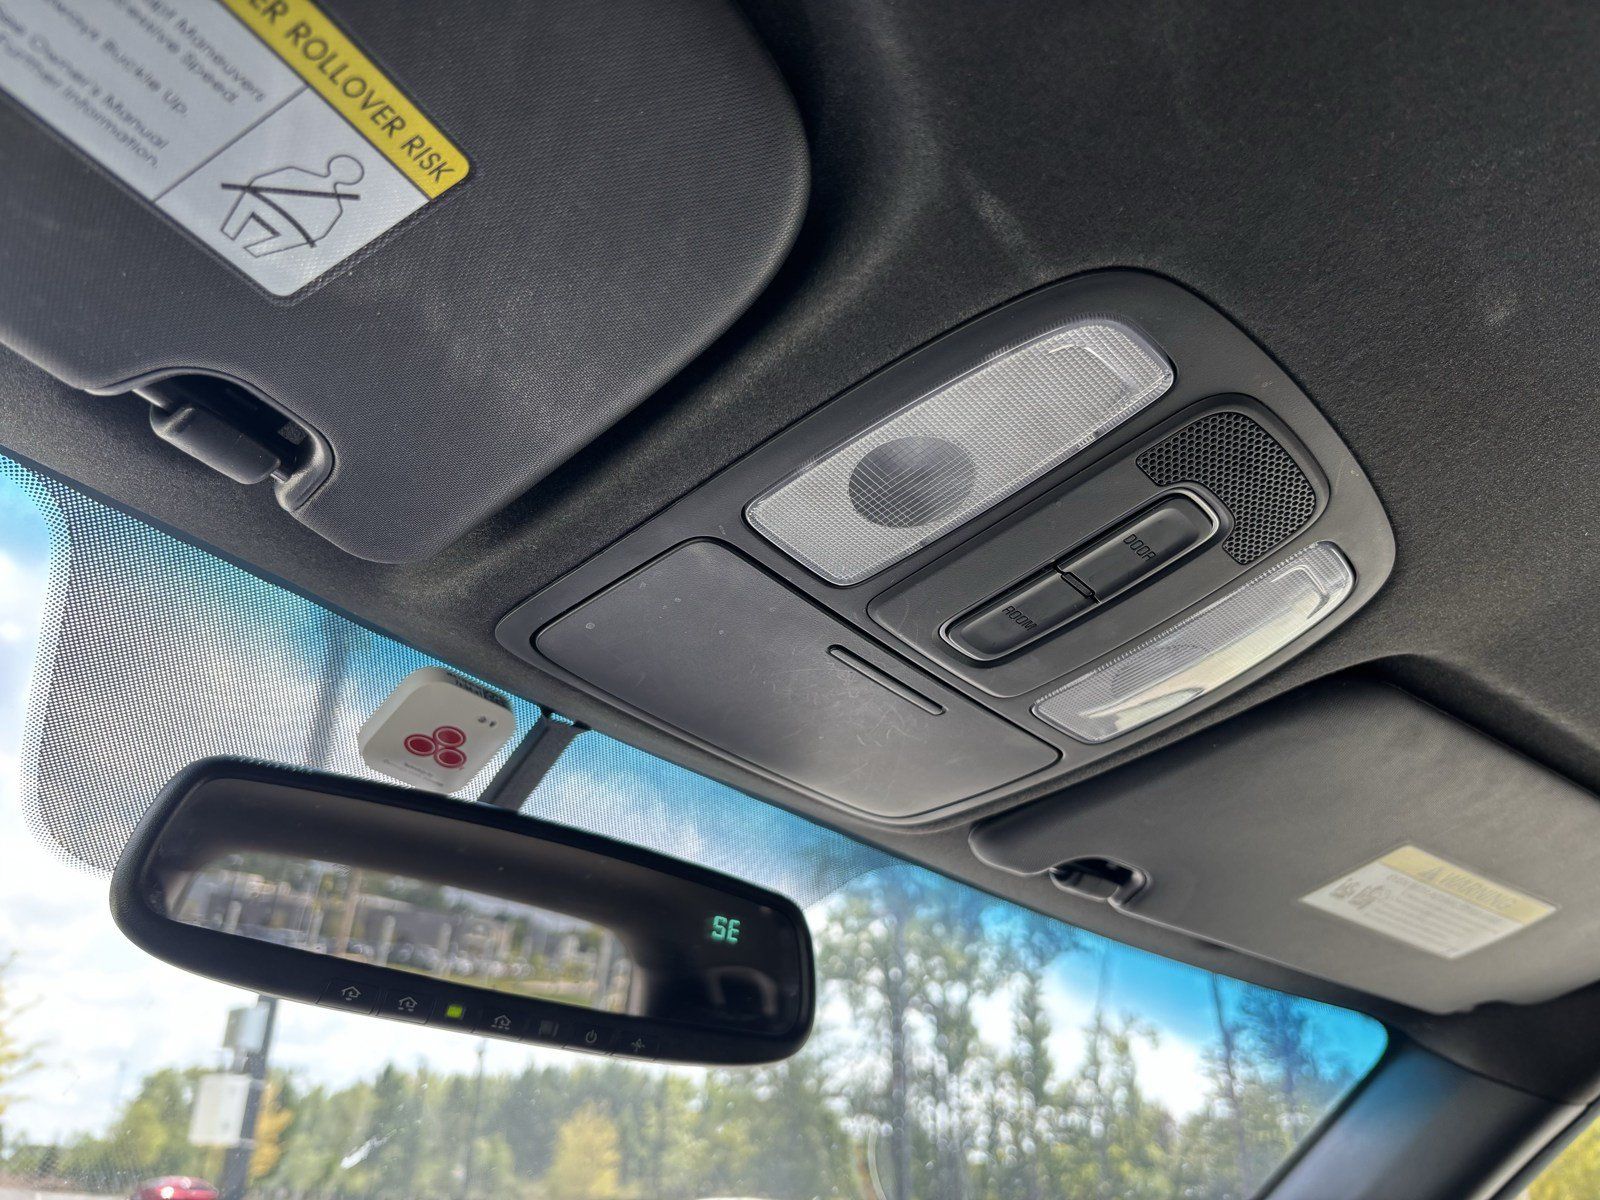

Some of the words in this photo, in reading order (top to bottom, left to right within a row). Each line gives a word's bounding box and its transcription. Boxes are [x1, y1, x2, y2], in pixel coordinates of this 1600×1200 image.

[101, 38, 162, 93] Buckle
[177, 18, 265, 102] Maneuvers
[62, 86, 160, 169] Information.
[103, 93, 169, 150] Manual
[285, 20, 406, 139] ROLLOVER
[400, 134, 455, 184] RISK
[1123, 533, 1157, 561] DOOR
[1001, 605, 1038, 631] ROOM
[711, 915, 740, 944] SE
